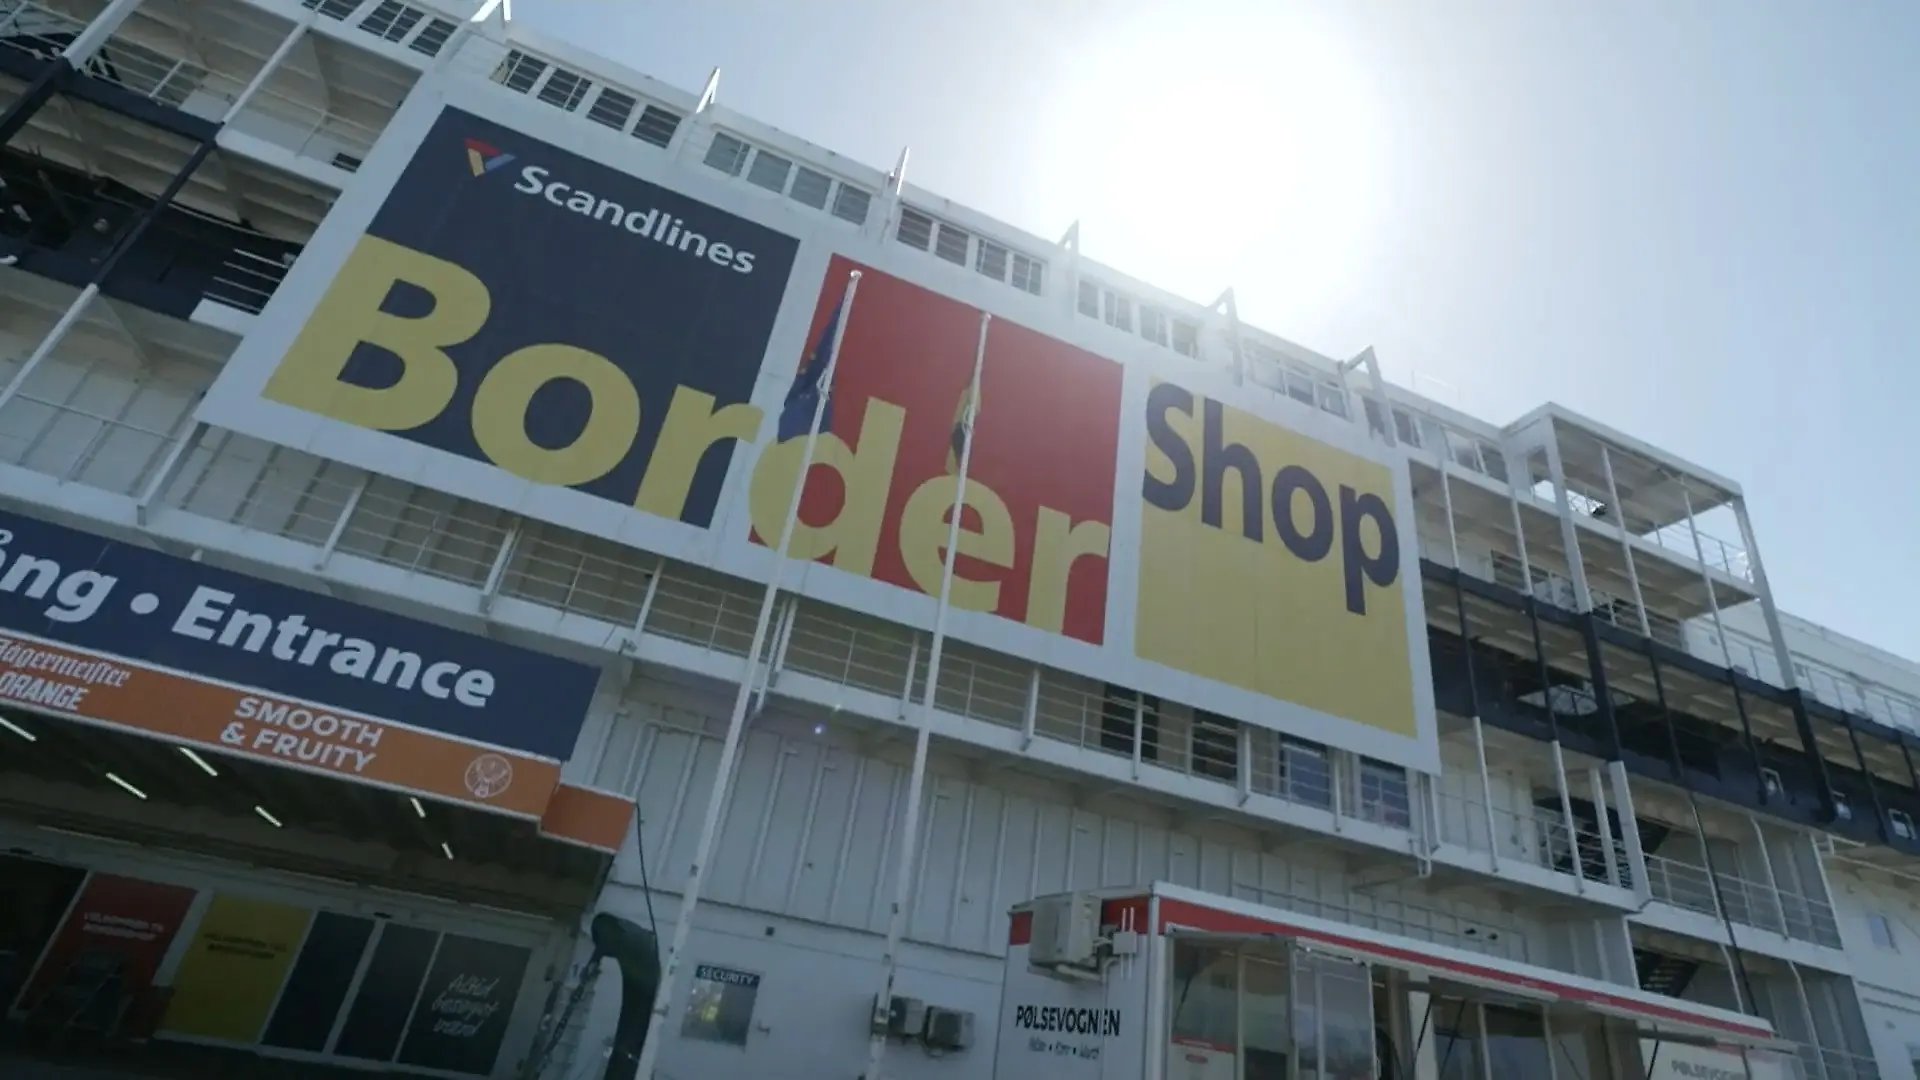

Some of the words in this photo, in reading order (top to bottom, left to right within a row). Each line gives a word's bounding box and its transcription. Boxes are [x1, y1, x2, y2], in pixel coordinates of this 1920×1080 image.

[514, 165, 756, 275] Scandlines
[263, 233, 1111, 634] Border
[1142, 382, 1400, 617] Shop
[172, 586, 496, 707] Entrance
[0, 670, 90, 711] ORANGE
[220, 721, 246, 746] &
[252, 728, 377, 772] FRUITY
[234, 697, 384, 748] SMOOTH
[701, 967, 754, 985] SECURITY
[1015, 1005, 1121, 1036] PØLSEVOGNEN
